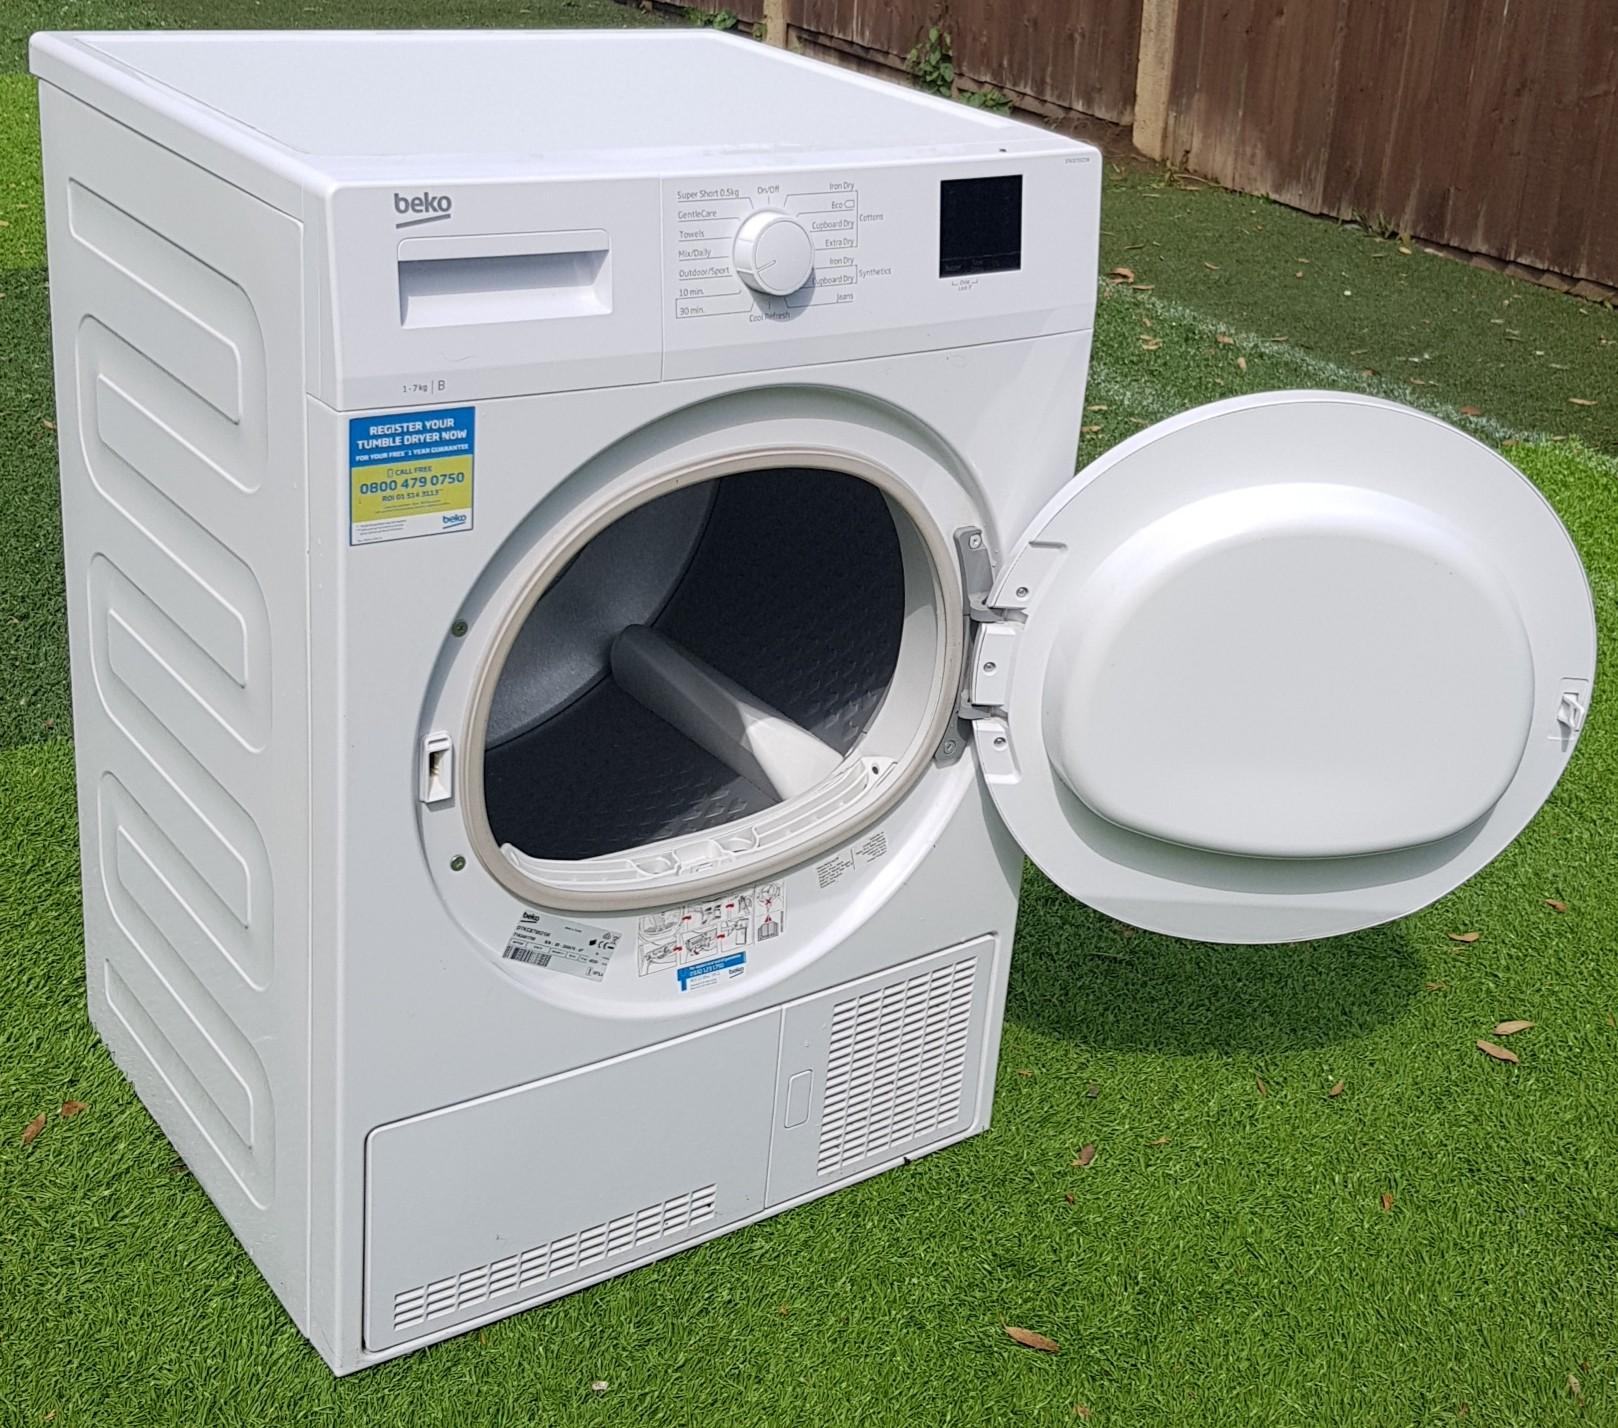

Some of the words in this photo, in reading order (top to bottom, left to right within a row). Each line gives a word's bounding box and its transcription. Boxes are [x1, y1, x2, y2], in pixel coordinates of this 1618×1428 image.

[757, 185, 780, 195] On/Off
[829, 182, 841, 191] Iron
[841, 182, 855, 192] Dry
[677, 190, 698, 200] Super
[699, 189, 719, 198] Short
[719, 188, 740, 199] 0.5kg
[394, 191, 452, 214] beko
[831, 200, 844, 209] Eco
[677, 209, 717, 218] GentleCare
[859, 213, 884, 222] Cottons
[811, 219, 842, 231] Cupboard
[842, 218, 854, 229] Dry
[679, 230, 705, 239] Towels
[825, 239, 841, 248] Extra
[841, 238, 854, 248] Dry
[678, 248, 711, 258] Mix/Daily
[829, 257, 841, 266] Iron
[841, 256, 855, 266] Dry
[678, 266, 730, 278] Outdoor/Sport
[859, 267, 892, 278] Synthetics
[842, 274, 854, 285] Dry
[679, 288, 690, 296] 10
[836, 292, 854, 302] Jeans
[679, 307, 690, 315] 30
[749, 313, 763, 322] Cool
[765, 311, 791, 321] Refresh
[437, 379, 446, 391] B
[369, 422, 423, 436] REGISTER
[425, 418, 455, 430] YOUR
[357, 436, 402, 450] TUMBLE
[404, 432, 440, 445] DRYER
[441, 429, 468, 440] NOW
[355, 454, 369, 462] FOR
[370, 452, 388, 460] YOUR
[413, 447, 431, 455] YEAR
[431, 443, 469, 453] GUARANTEE
[395, 467, 413, 476] CALL
[414, 465, 433, 473] FREE
[360, 480, 398, 495] 0800
[400, 475, 427, 489] 479
[430, 472, 465, 486] 0750
[442, 514, 467, 524] beko
[522, 911, 540, 921] beko
